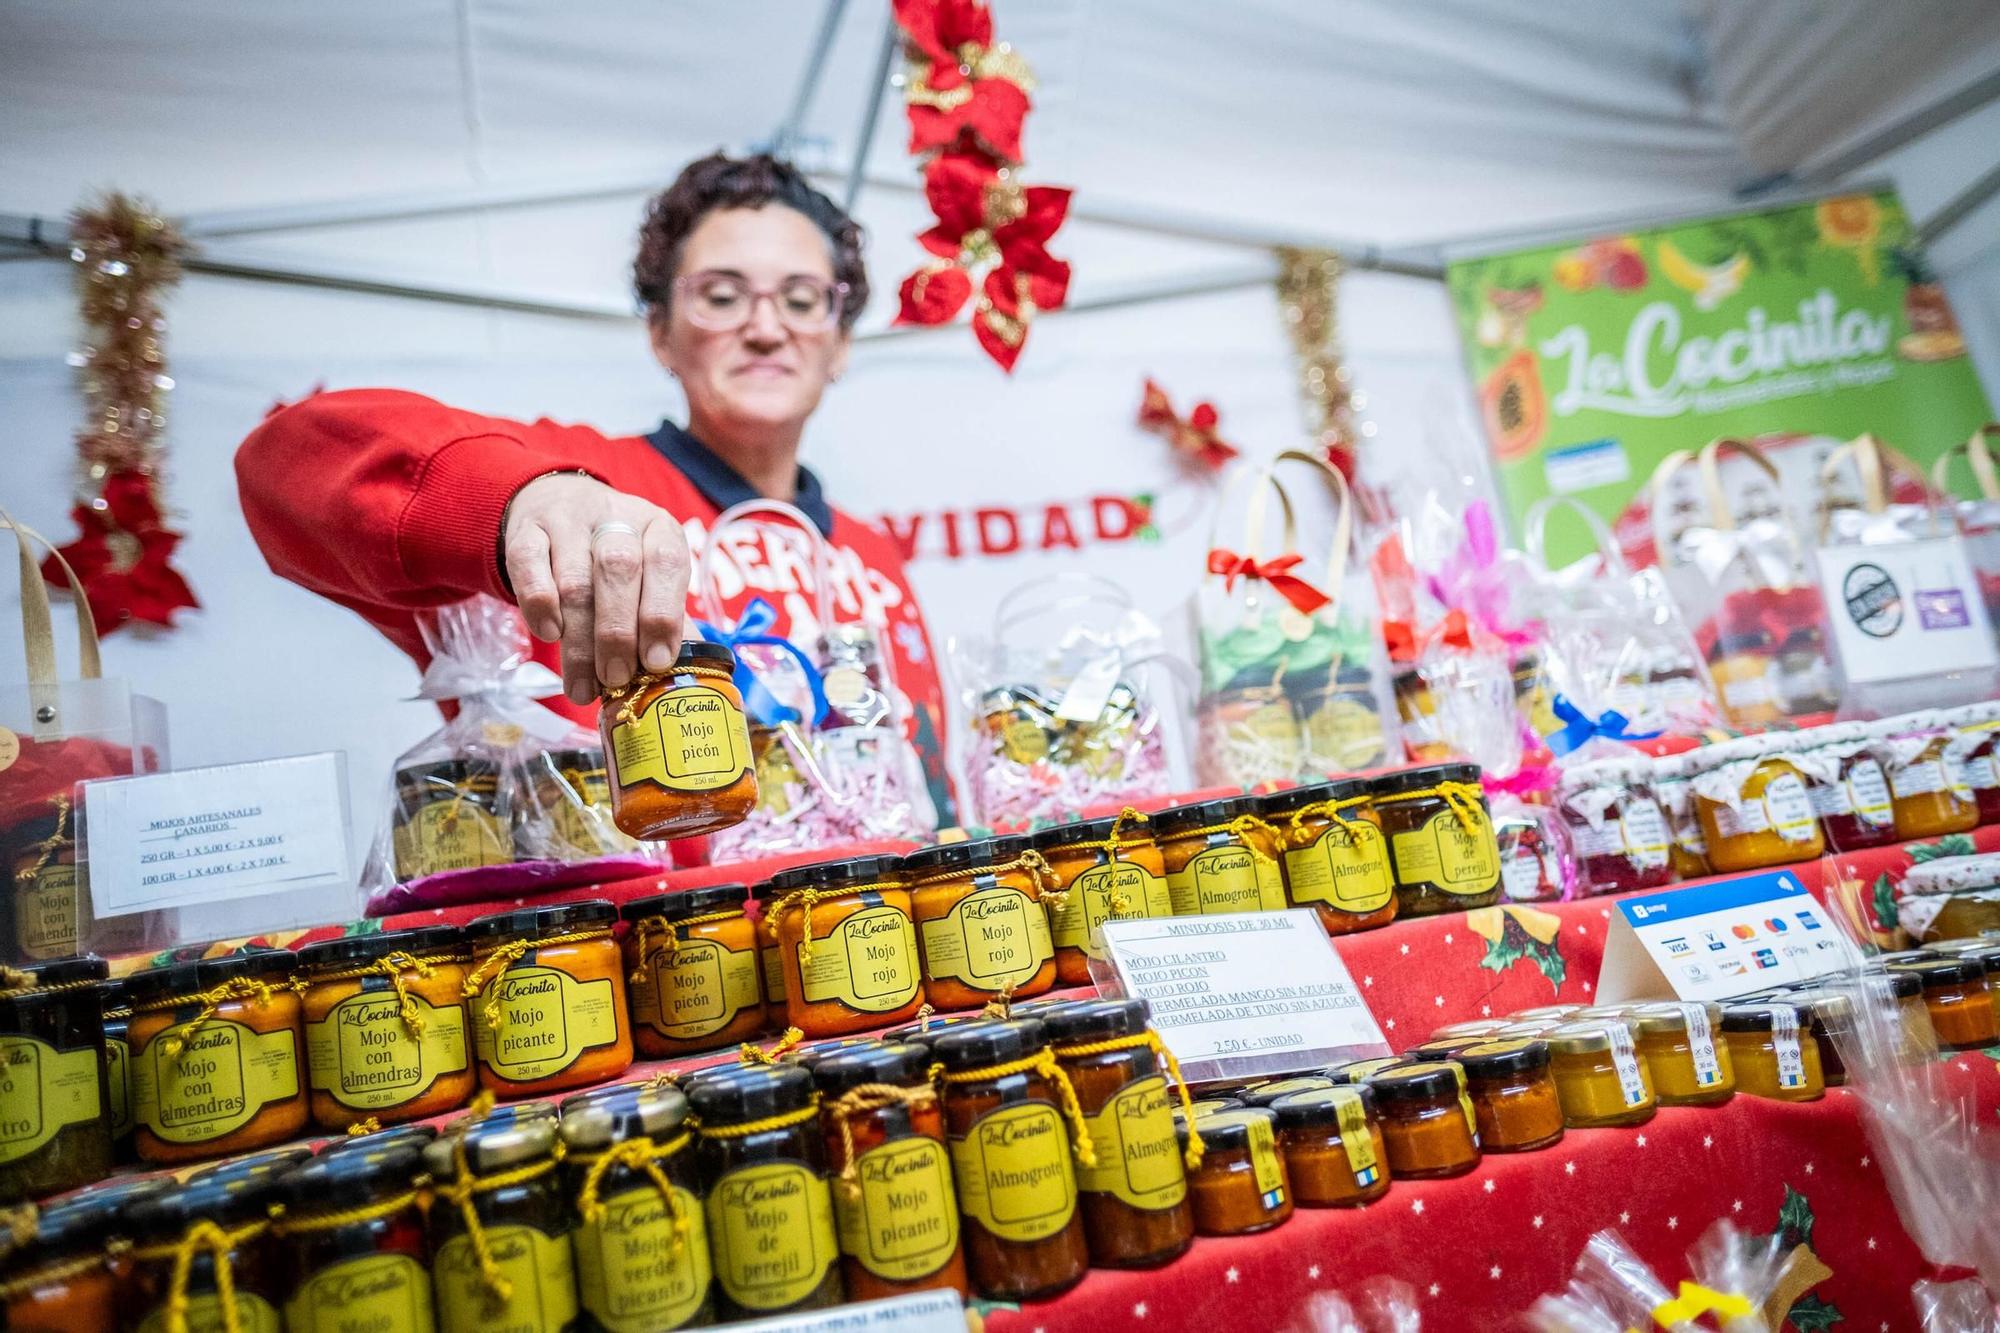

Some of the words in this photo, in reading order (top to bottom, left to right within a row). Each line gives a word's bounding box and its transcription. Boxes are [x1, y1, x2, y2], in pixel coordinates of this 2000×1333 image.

[1540, 325, 1627, 416] La
[1624, 289, 1893, 402] Cocinita
[881, 496, 1133, 563] VIDAD
[662, 701, 678, 717] La
[675, 699, 722, 717] Cocinita
[681, 723, 714, 740] Mojo
[682, 743, 720, 764] picón
[150, 817, 186, 831] MOJOS
[187, 807, 262, 826] ARTESANALES
[140, 853, 158, 864] 250
[160, 850, 175, 861] GR
[194, 847, 202, 856] X
[225, 842, 233, 851] €
[240, 840, 246, 848] 2
[246, 838, 255, 848] X
[278, 834, 285, 843] €
[142, 874, 159, 886] 100
[161, 872, 176, 883] GR
[195, 869, 203, 878] X
[226, 864, 234, 872] €
[241, 861, 246, 869] 2
[248, 860, 256, 869] X
[279, 855, 286, 864] €
[1199, 861, 1212, 874] La
[1211, 856, 1251, 875] Cocinita
[1454, 861, 1487, 879] perejil
[1086, 878, 1099, 891] La
[1098, 873, 1139, 892] Coinita
[39, 894, 70, 911] Mojo
[1102, 892, 1132, 908] Mo
[1202, 888, 1258, 905] Almogrote
[964, 903, 977, 918] La
[976, 898, 1020, 918] Cocinita
[43, 913, 66, 925] con
[849, 923, 862, 938] La
[861, 918, 901, 938] Cocinita
[1167, 923, 1237, 936] MINIDOSIS
[1238, 921, 1256, 931] DE
[1257, 918, 1272, 930] 30
[1273, 917, 1294, 929] ML
[982, 926, 1013, 944] Mojo
[867, 946, 896, 963] Mojo
[989, 948, 1015, 967] rojo
[1669, 942, 1690, 954] VISA
[657, 953, 671, 969] La
[670, 950, 714, 969] Cocinita
[1124, 956, 1162, 971] MOJO
[1162, 951, 1227, 967] CILANTRO
[674, 973, 705, 990] Mojo
[872, 966, 897, 985] rojo
[1131, 970, 1168, 985] MOJO
[1170, 966, 1209, 981] PICON
[506, 979, 558, 1002] Cocinita
[1138, 985, 1175, 999] MOJO
[1177, 981, 1210, 995] ROJO
[1229, 989, 1275, 1004] MANGO
[1277, 986, 1297, 998] SIN
[1297, 982, 1346, 996] AZUCAR
[674, 993, 710, 1013] picón
[1151, 1007, 1234, 1028] MERMELADA
[1236, 1006, 1253, 1018] DE
[1255, 1002, 1290, 1016] TUNO
[1291, 1000, 1310, 1012] SIN
[1311, 995, 1360, 1010] AZUCAR
[342, 1009, 357, 1026] La
[356, 1003, 402, 1027] Cocinit
[509, 1008, 545, 1027] Mojo
[184, 1032, 234, 1053] ocinita
[360, 1028, 397, 1049] Mojo
[503, 1031, 555, 1054] picante
[1214, 1039, 1241, 1054] 2,50
[1258, 1033, 1304, 1048] UNIDAD
[366, 1051, 393, 1066] con
[176, 1058, 217, 1080] Mojo
[343, 1065, 421, 1088] almendras
[517, 1066, 530, 1076] 250
[183, 1081, 213, 1098] con
[367, 1093, 383, 1104] 250
[162, 1095, 245, 1122] almendras
[185, 1126, 202, 1137] 250
[1002, 1119, 1054, 1147] Cocinita
[884, 1154, 935, 1181] Cocinita
[989, 1163, 1063, 1190] Almogrote
[744, 1179, 801, 1204] Cocinita
[887, 1190, 928, 1213] Mojo
[745, 1209, 789, 1231] Mojo
[881, 1217, 941, 1247] picante
[759, 1234, 779, 1252] de
[743, 1256, 800, 1285] perejil
